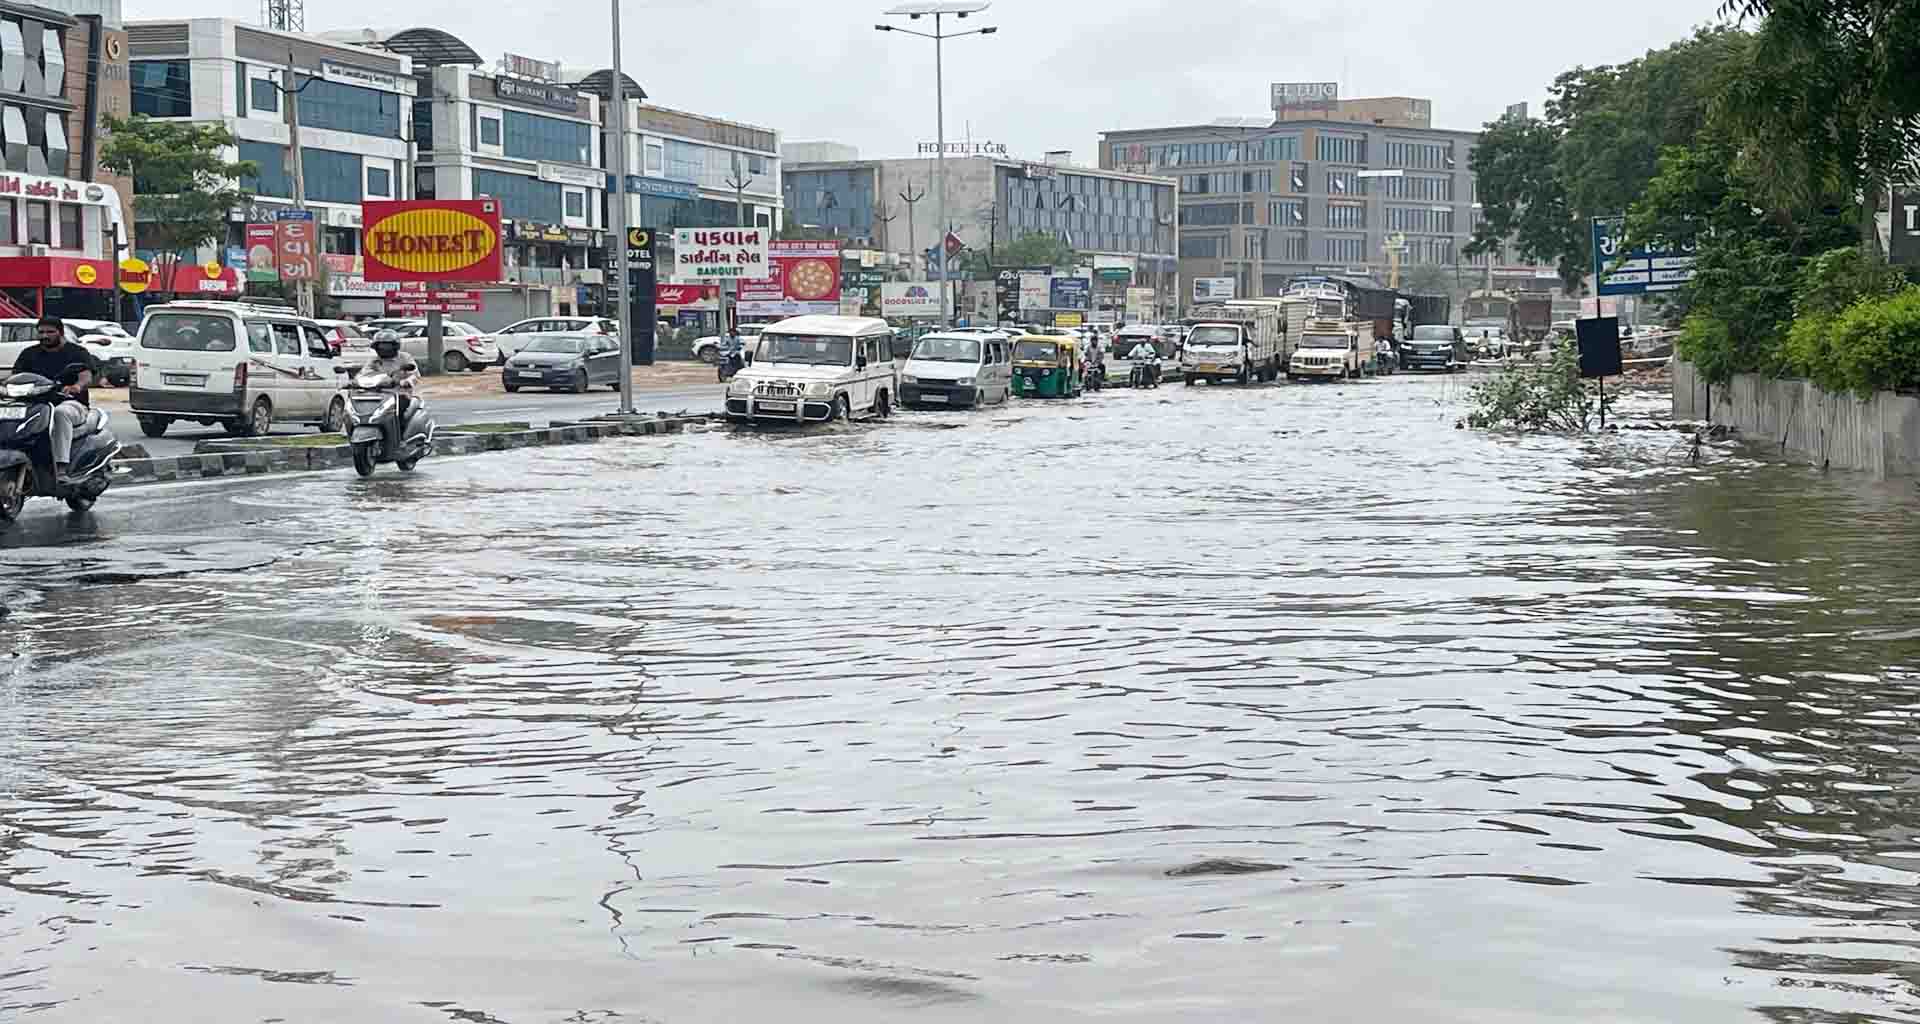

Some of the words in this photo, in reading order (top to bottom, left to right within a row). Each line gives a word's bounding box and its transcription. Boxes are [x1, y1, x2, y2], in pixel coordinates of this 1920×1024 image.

[374, 229, 484, 256] HONEST
[694, 231, 760, 246] પકવાન
[736, 249, 761, 264] હોલ
[697, 266, 744, 276] BANQUET
